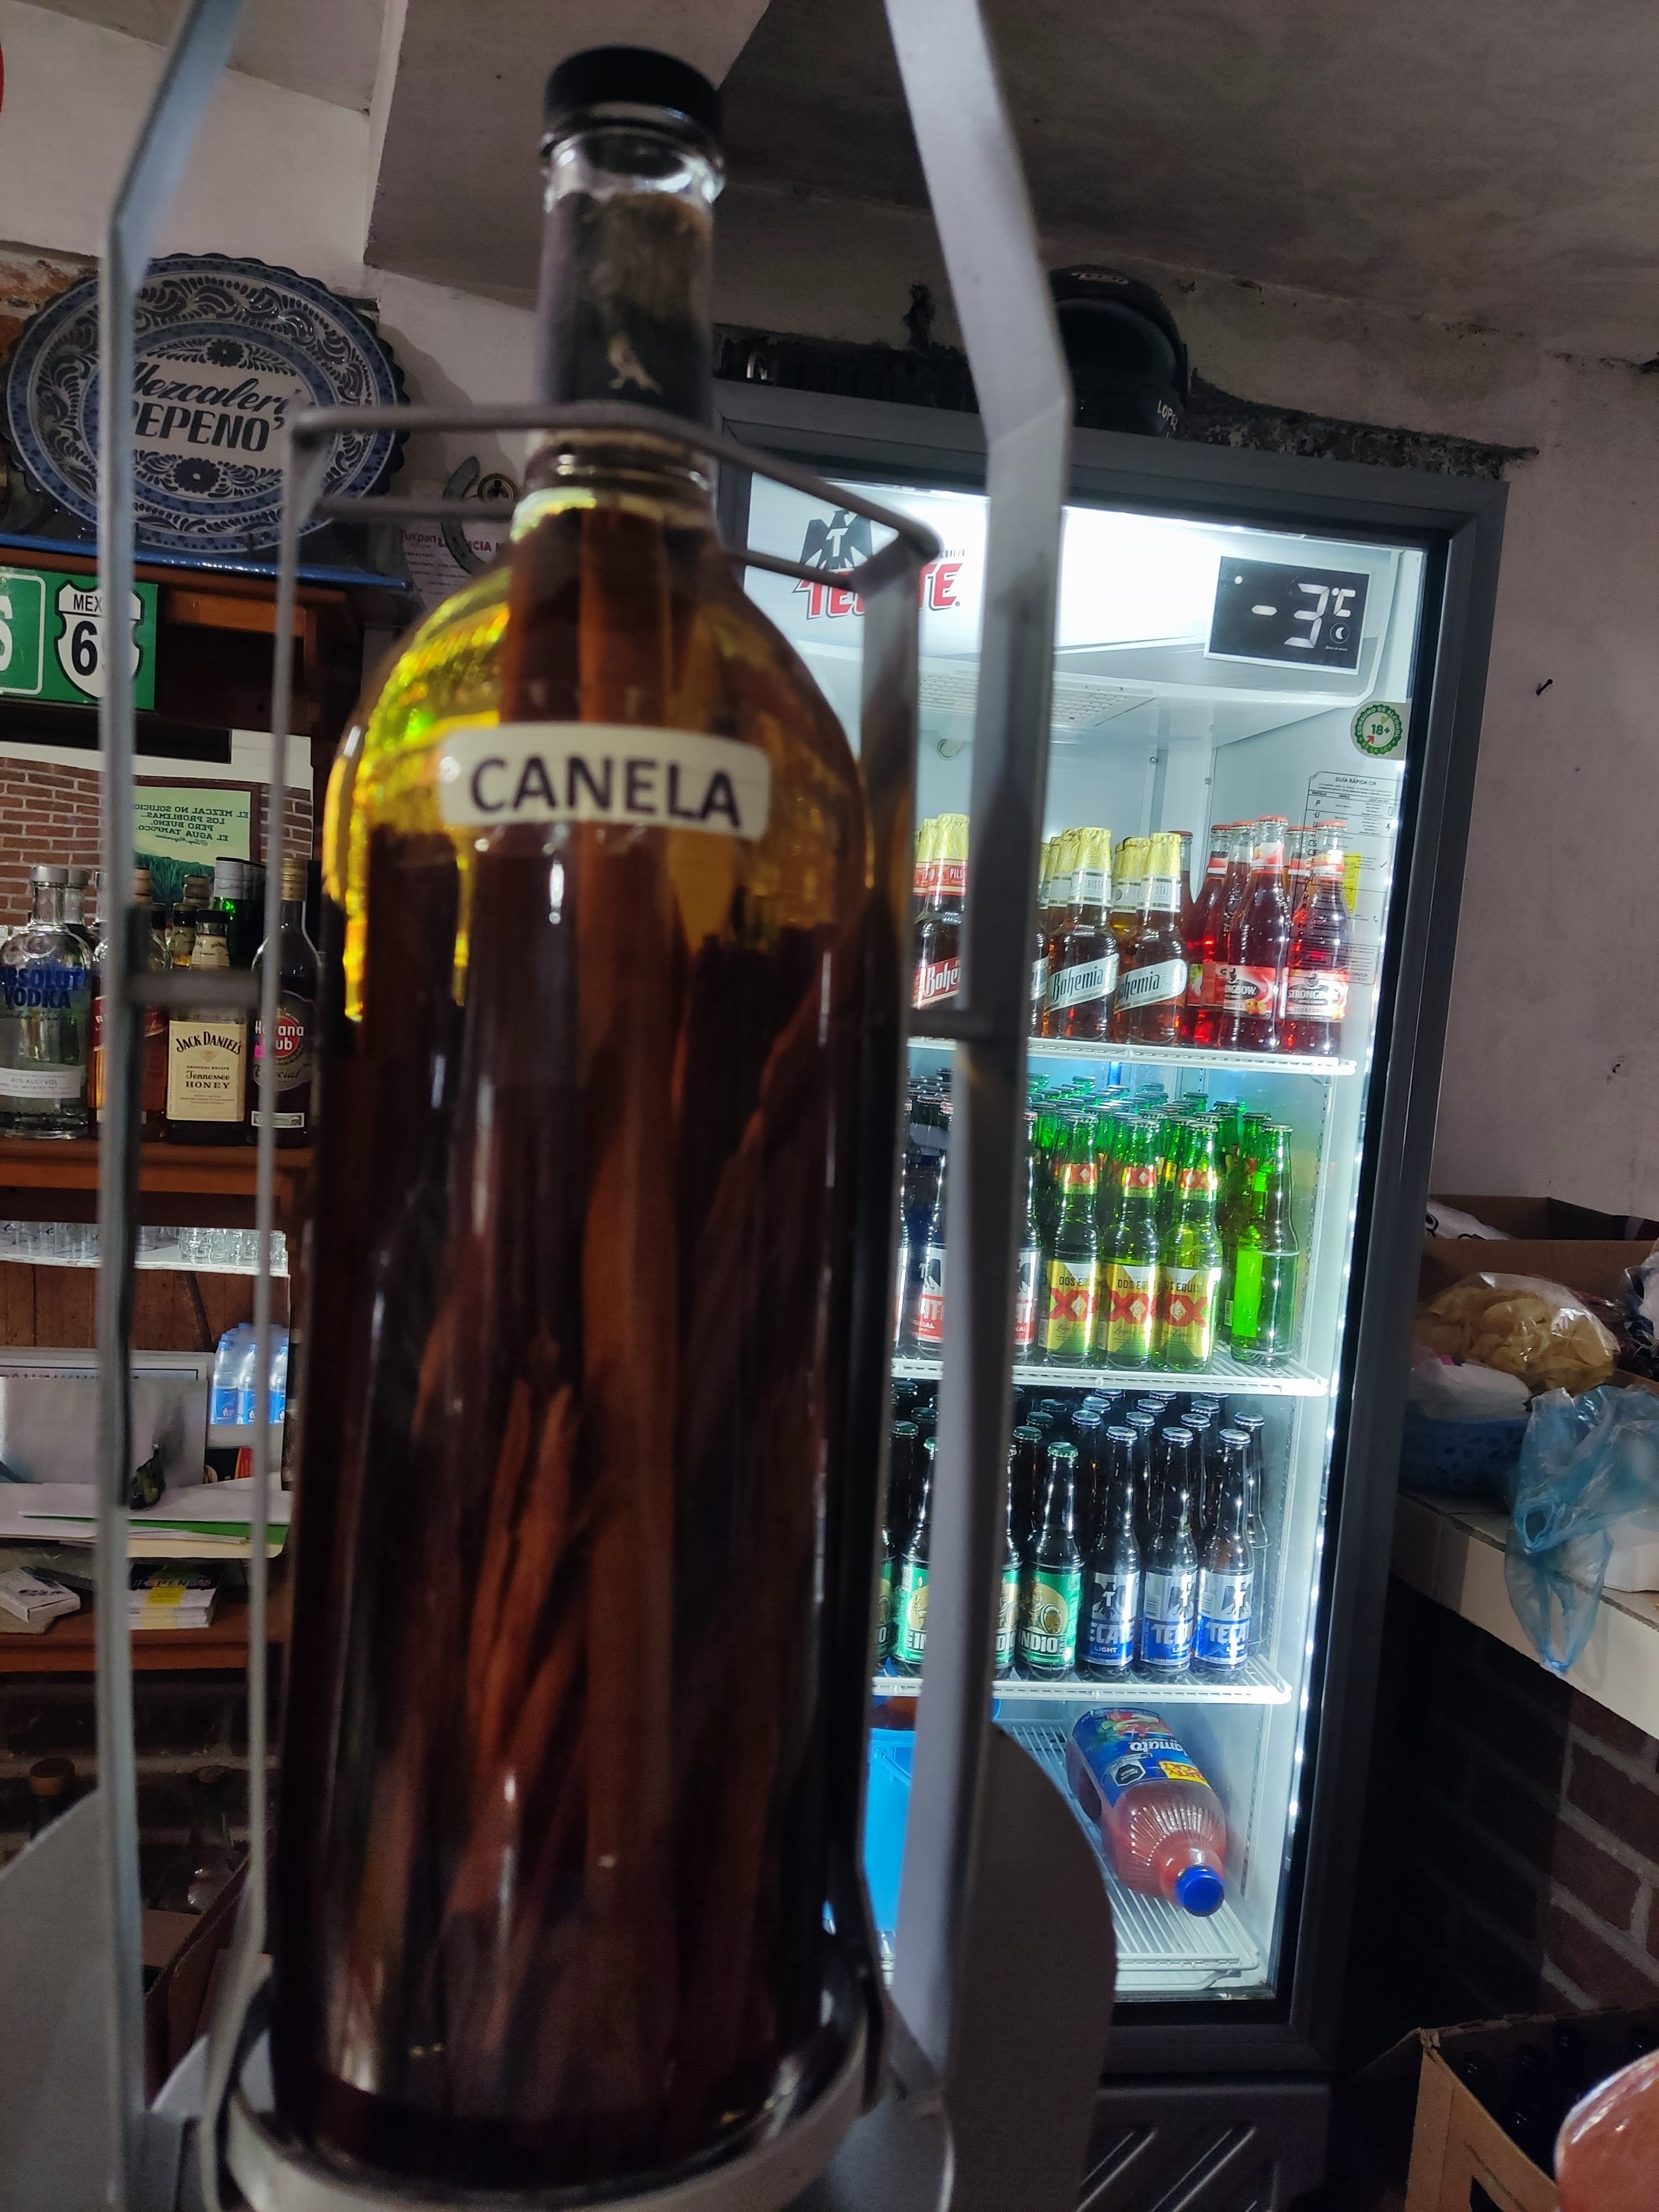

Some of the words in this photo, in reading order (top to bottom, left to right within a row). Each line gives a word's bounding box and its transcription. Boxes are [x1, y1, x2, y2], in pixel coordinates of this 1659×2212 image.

[404, 531, 436, 544] uxpan
[72, 620, 107, 676] 6
[1357, 707, 1376, 735] CONSUMO
[1371, 724, 1390, 735] 18+
[471, 753, 740, 828] CANELA
[1156, 885, 1169, 895] STAL
[924, 962, 961, 997] Bohe
[1052, 966, 1104, 1003] Bohemia
[5, 986, 71, 1009] VODKA
[176, 1035, 202, 1053] JACK
[203, 1031, 242, 1055] DANIEL'S
[185, 1070, 231, 1081] Tennessee
[1059, 1276, 1076, 1286] DOS
[1118, 1279, 1134, 1289] DOS
[1094, 1646, 1118, 1654] LIGHT
[1130, 1741, 1188, 1757] lamato
